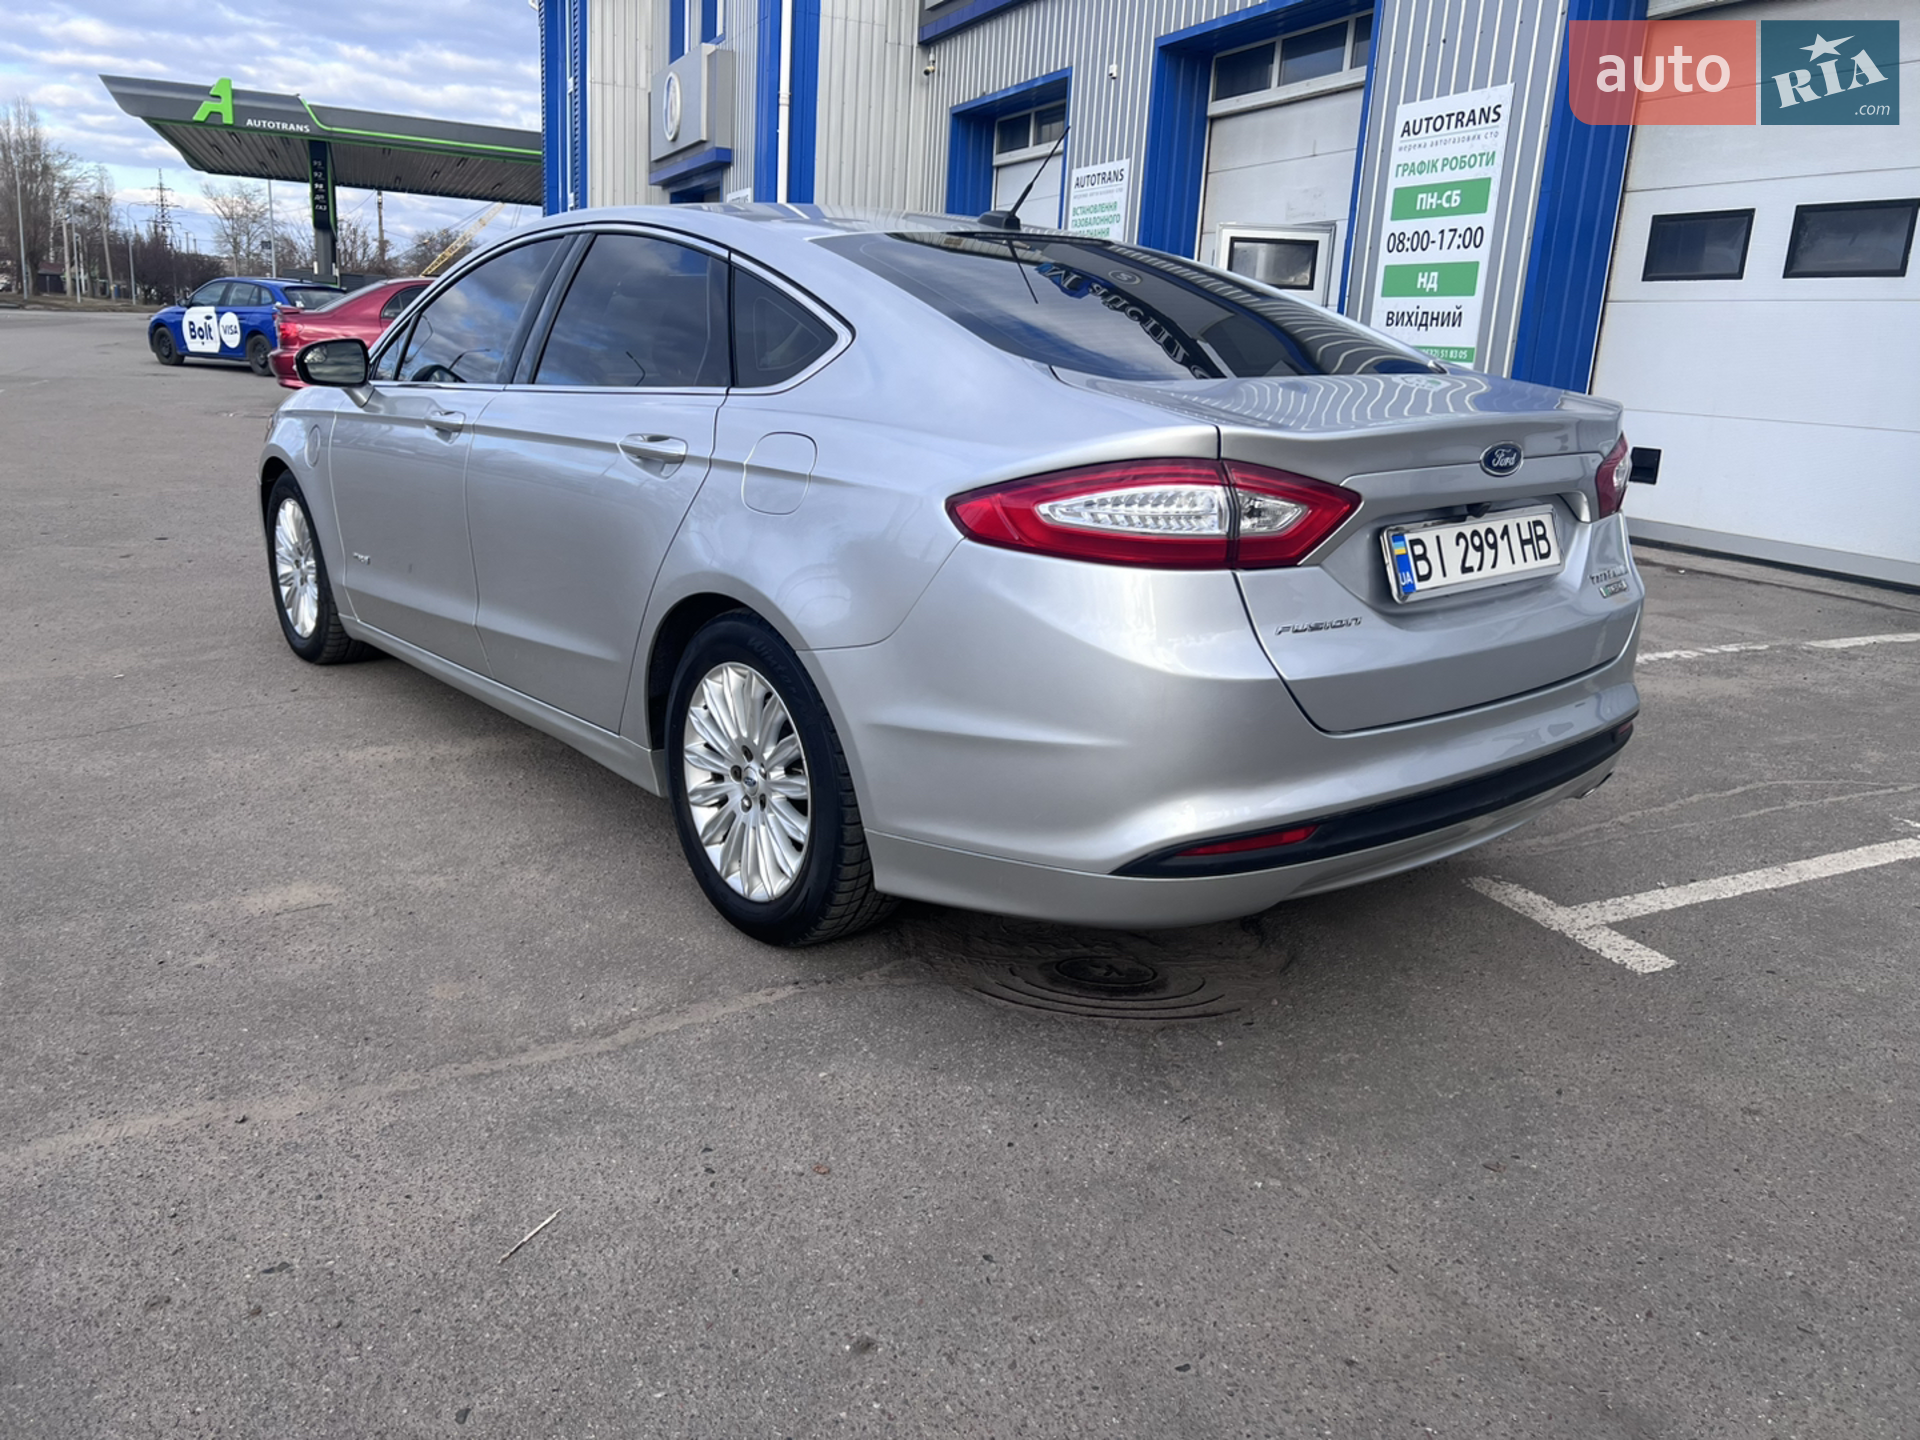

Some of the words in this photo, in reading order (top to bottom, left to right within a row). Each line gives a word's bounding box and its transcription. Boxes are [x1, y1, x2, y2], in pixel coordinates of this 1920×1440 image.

[246, 118, 310, 133] AUTOTRANS
[1400, 104, 1502, 138] AUTOTRANS
[1395, 158, 1439, 178] ГРАФІК
[1441, 150, 1496, 172] РОБОТИ
[1074, 168, 1124, 189] AUTOTRANS
[1416, 189, 1461, 210] ПН-СБ
[1386, 226, 1484, 253] 08:00-17:00
[1416, 271, 1439, 292] НД
[188, 321, 214, 341] Bolt
[221, 323, 239, 336] VISA
[1491, 448, 1516, 467] Ford
[1408, 535, 1447, 583] BI
[1455, 524, 1516, 575] 2991
[1400, 571, 1414, 586] UA
[1275, 617, 1362, 636] FUSION
